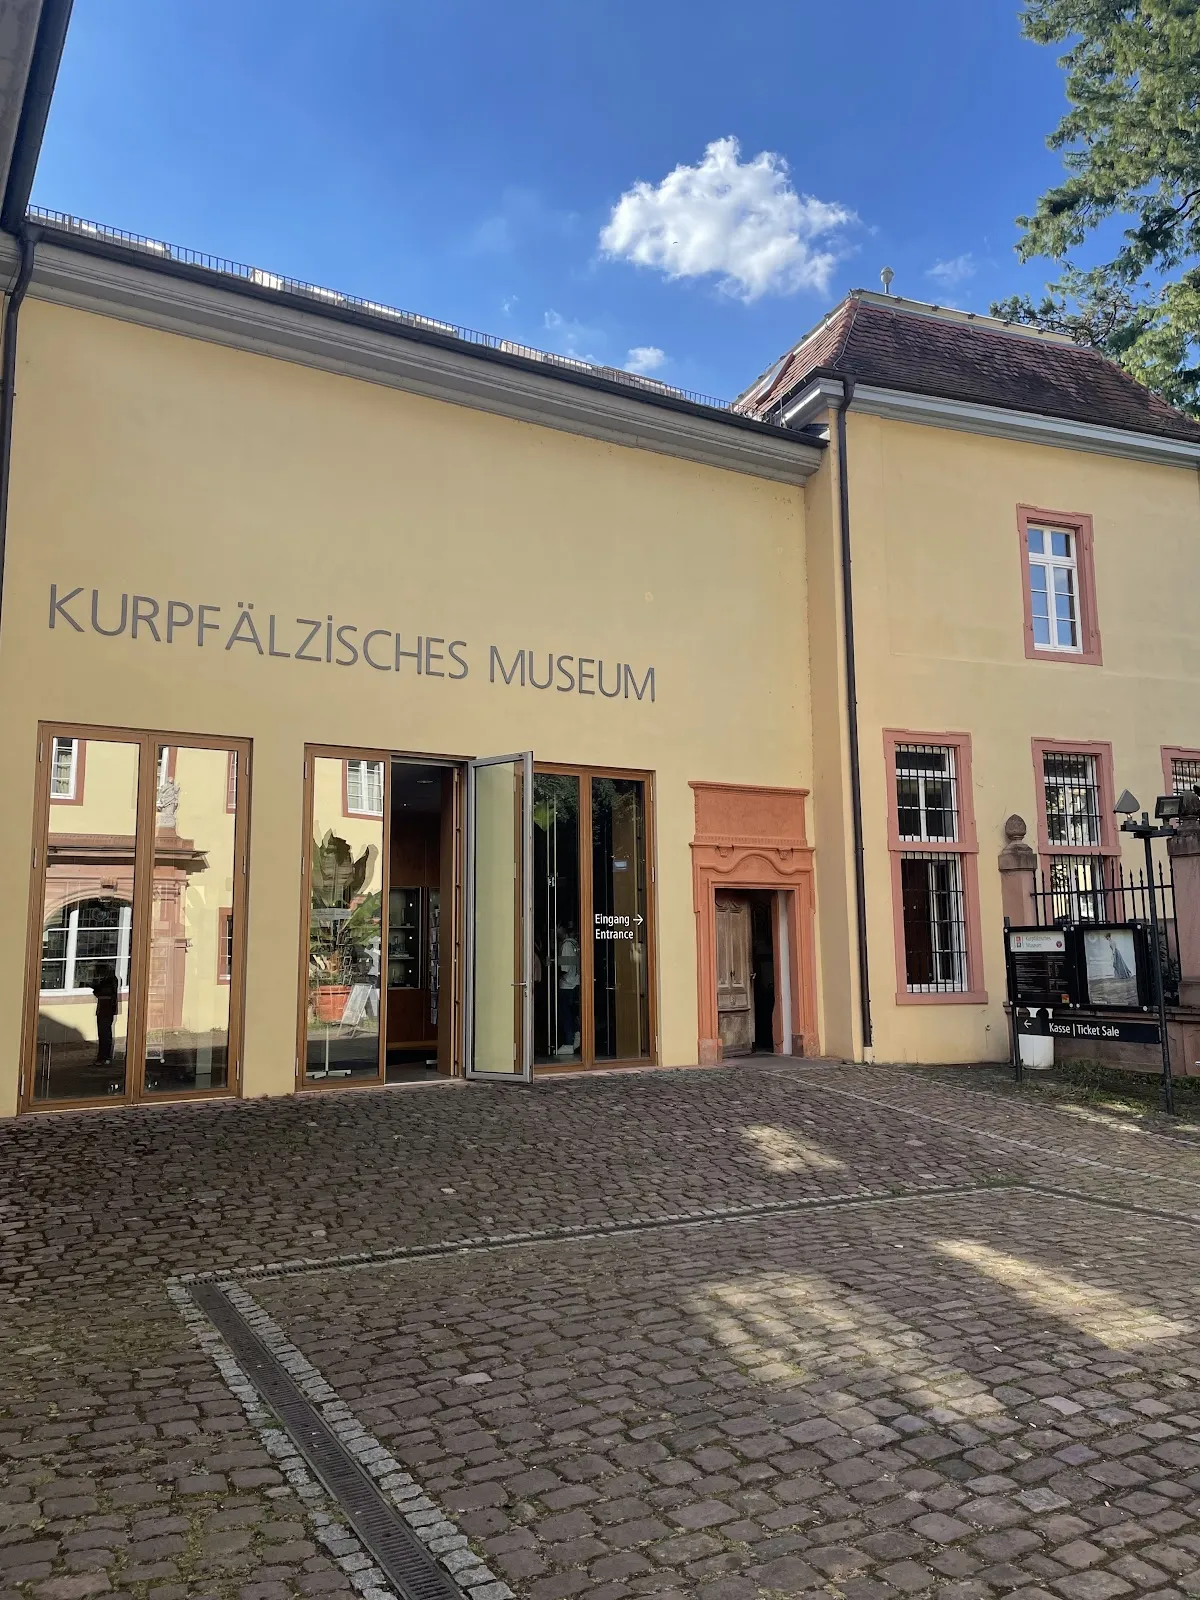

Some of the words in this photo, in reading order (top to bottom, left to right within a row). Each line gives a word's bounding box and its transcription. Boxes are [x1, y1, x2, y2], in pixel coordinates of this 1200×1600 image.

[490, 646, 655, 702] MUSEUM
[595, 913, 629, 926] Eingang
[596, 929, 633, 939] Entrance
[1049, 1023, 1070, 1033] Kasse
[1077, 1025, 1100, 1036] Ticket
[1102, 1026, 1119, 1037] Sale
